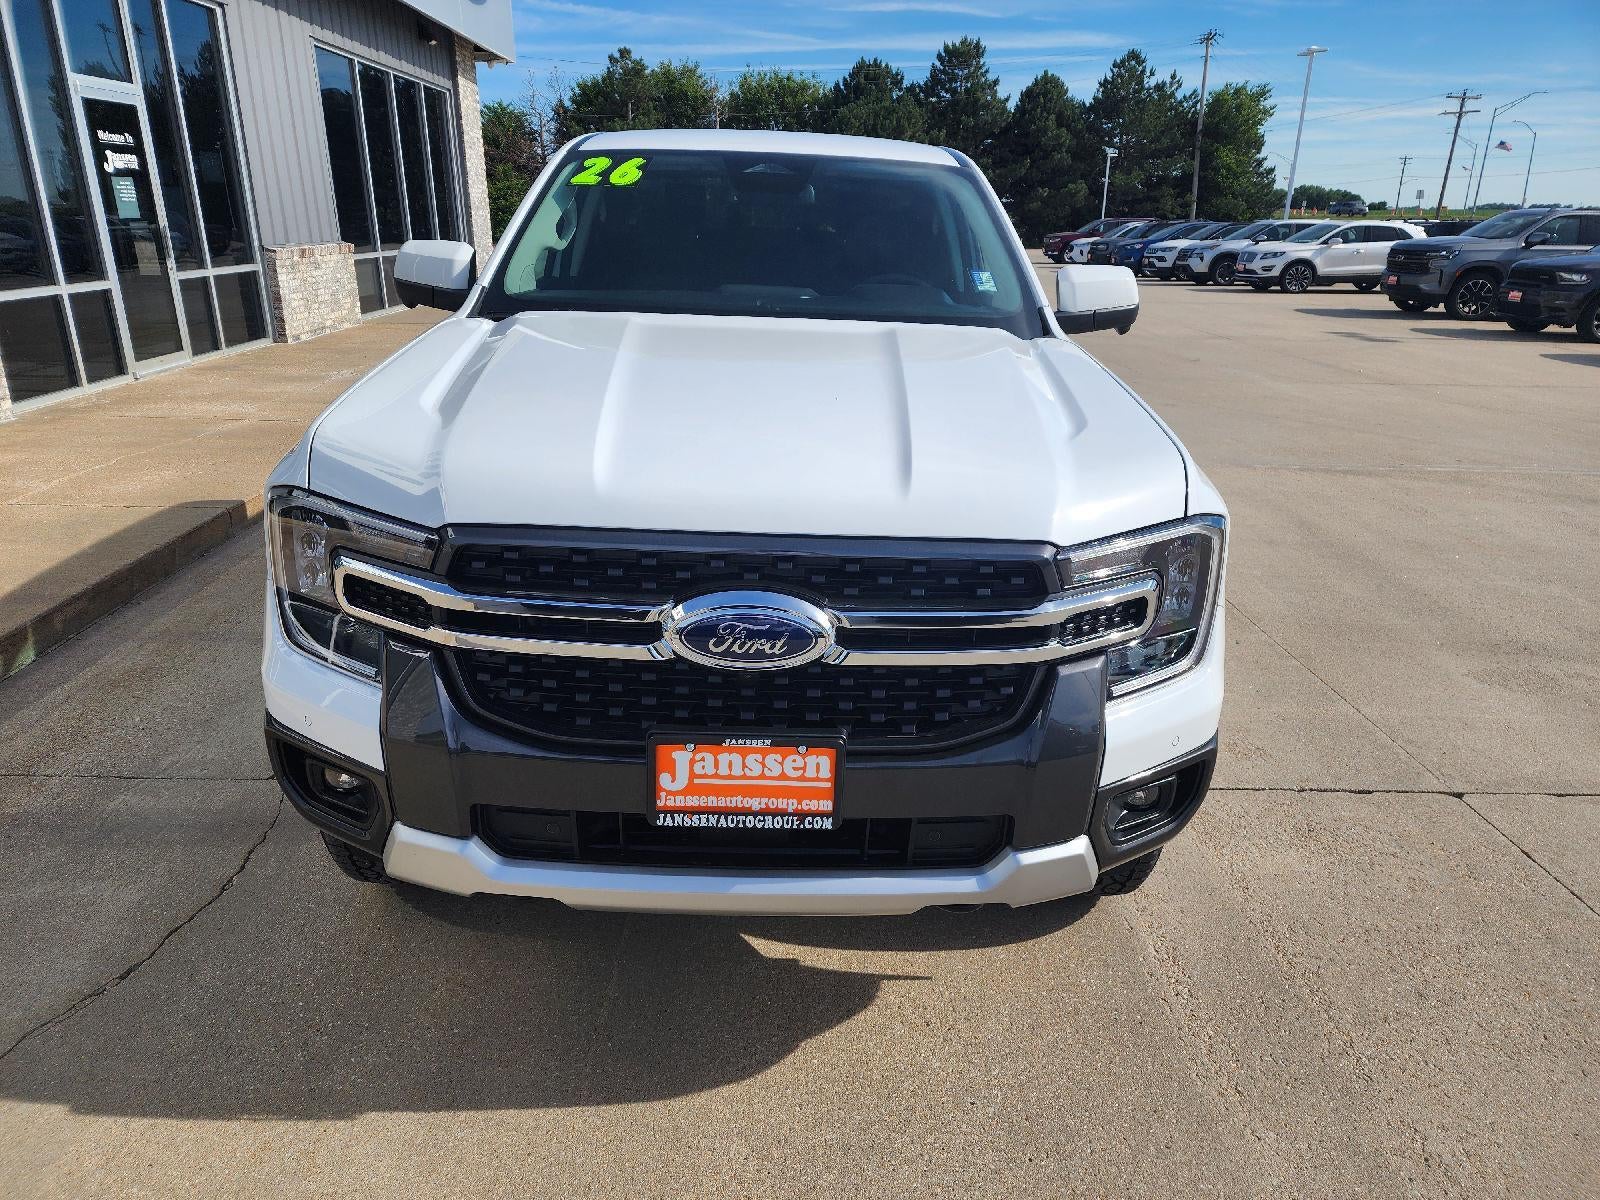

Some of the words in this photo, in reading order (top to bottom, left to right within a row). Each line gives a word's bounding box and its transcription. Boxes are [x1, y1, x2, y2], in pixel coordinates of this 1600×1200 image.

[97, 130, 125, 142] Welcome
[124, 133, 133, 143] To
[570, 157, 647, 185] 26
[708, 622, 790, 655] Ford
[722, 738, 772, 747] JANSSEN
[659, 750, 831, 791] Janssen
[656, 792, 833, 812] Janssenautogroup.com
